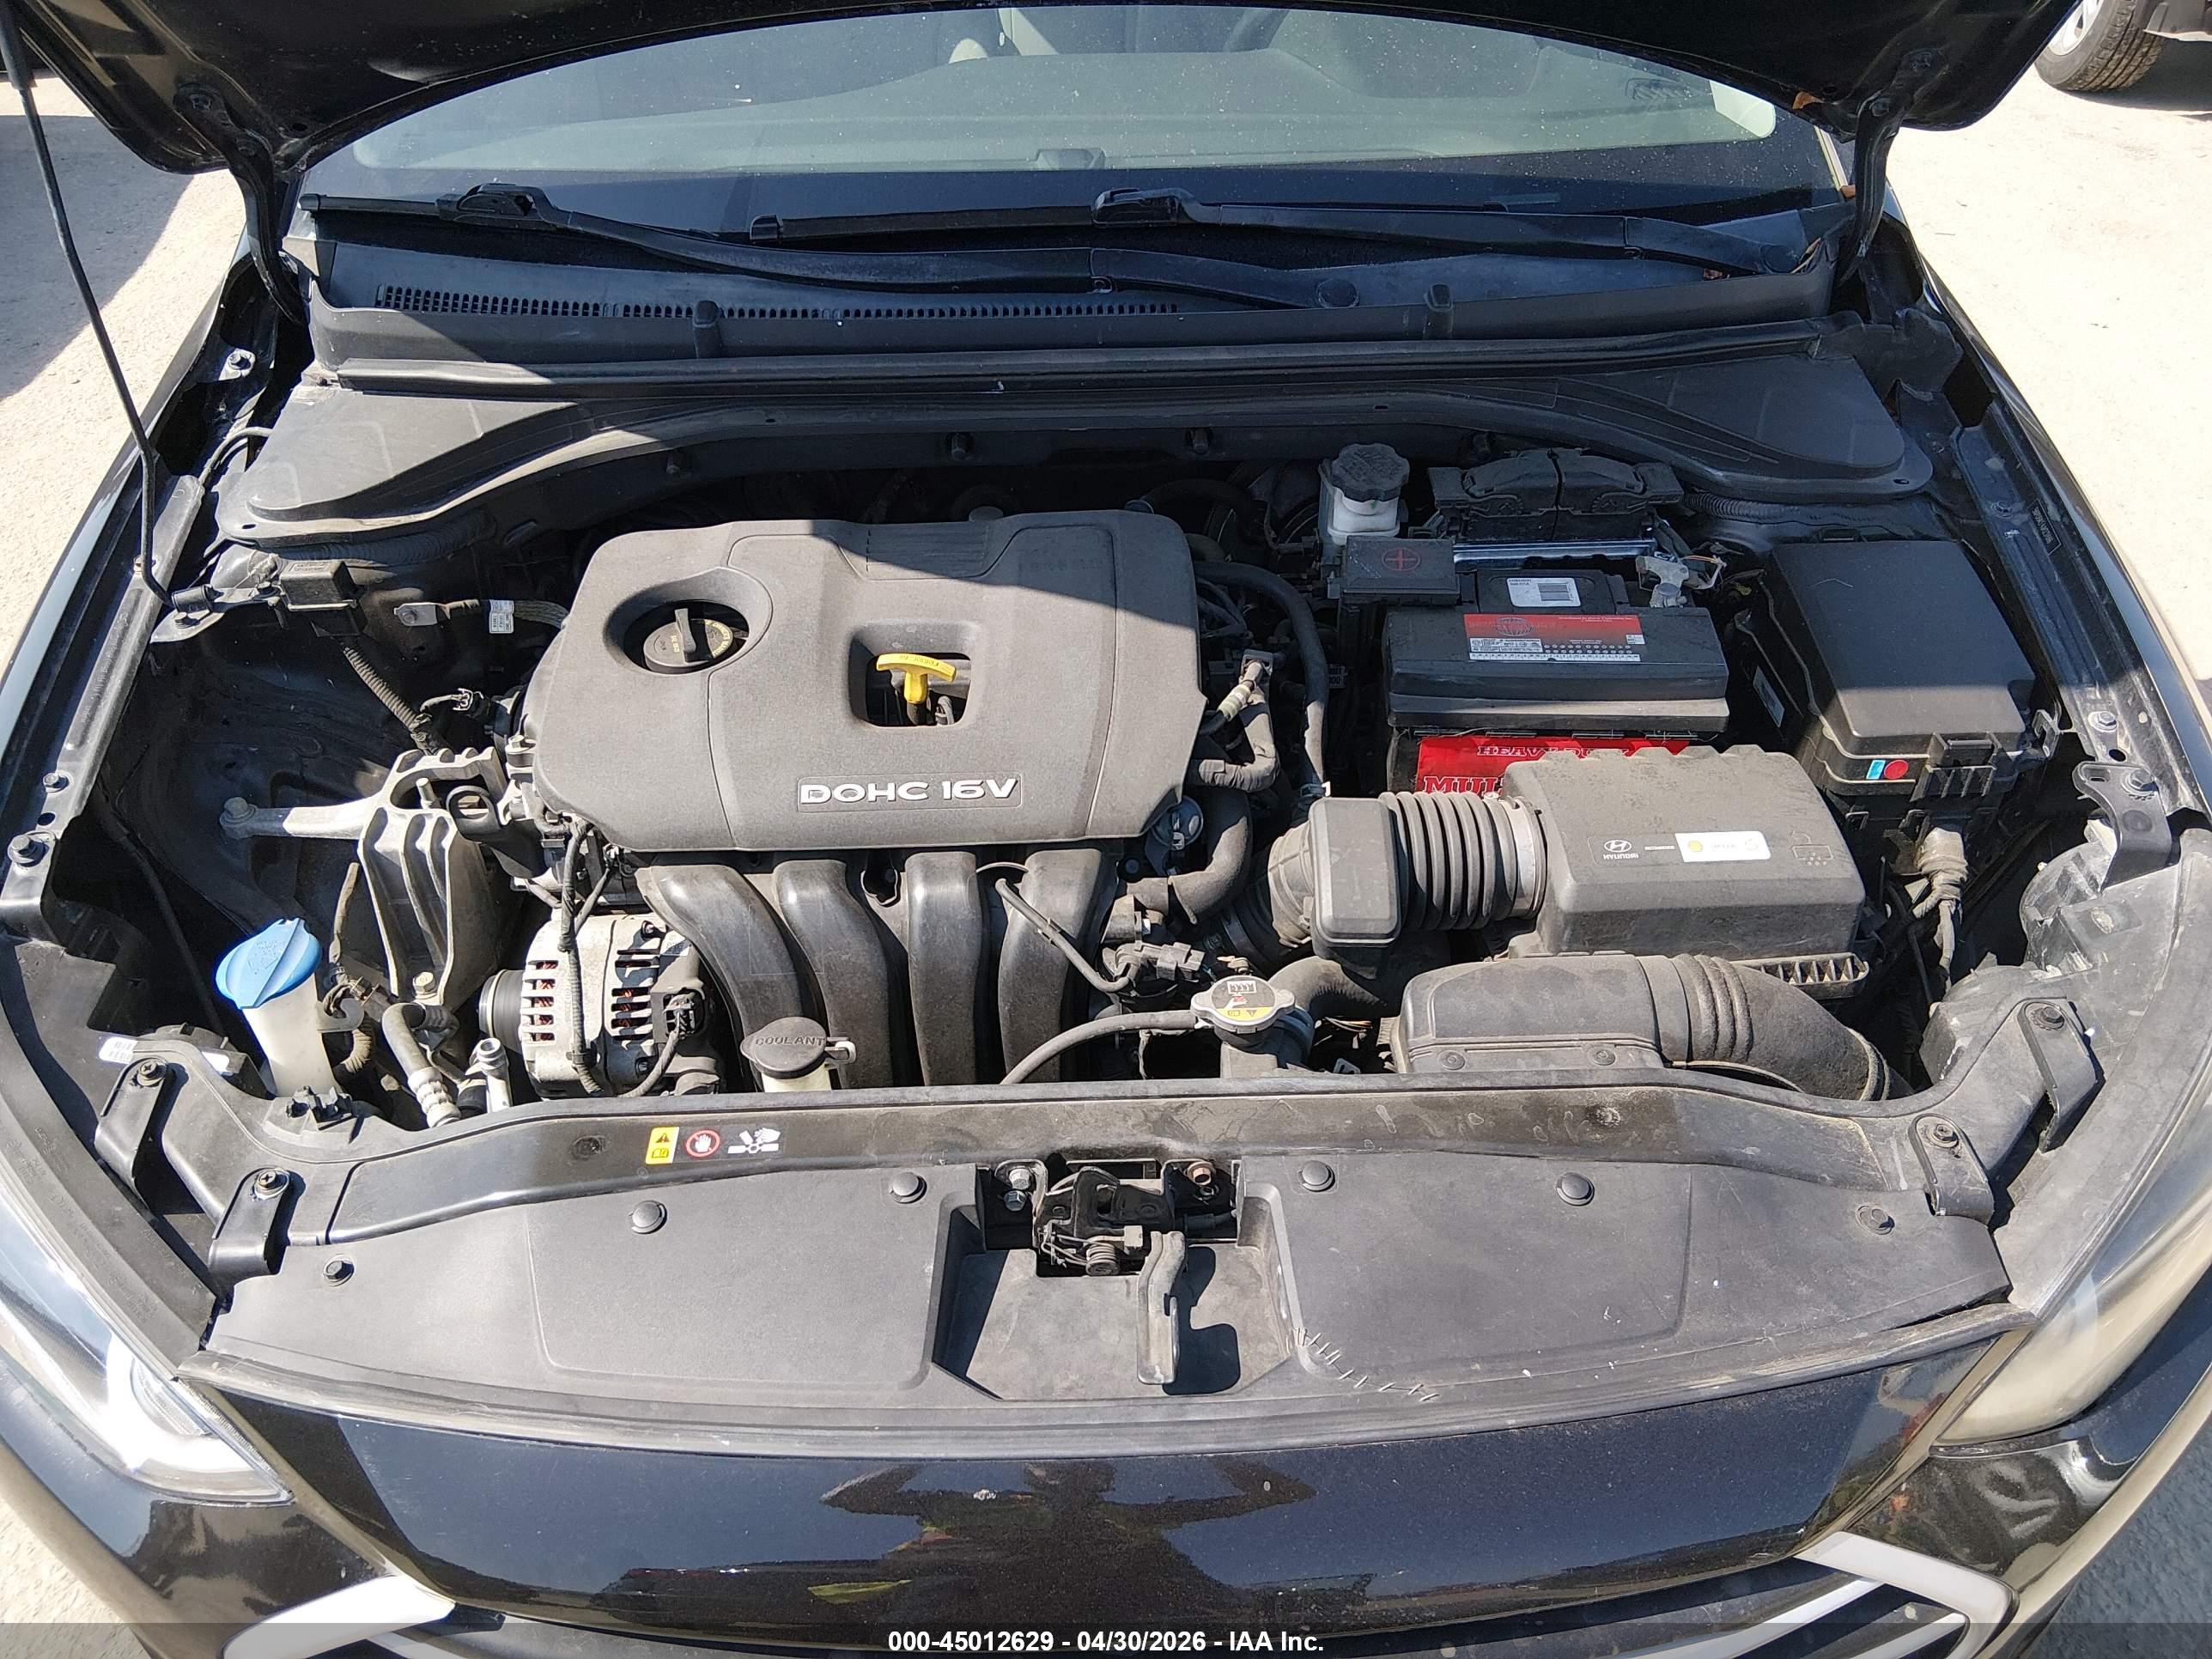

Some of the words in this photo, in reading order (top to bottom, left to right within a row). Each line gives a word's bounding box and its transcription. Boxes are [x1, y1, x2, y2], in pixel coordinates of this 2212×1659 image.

[800, 781, 929, 804] DOHC
[941, 778, 1018, 800] 16V
[1424, 775, 1503, 795] MUL
[755, 1036, 825, 1046] COOLANT
